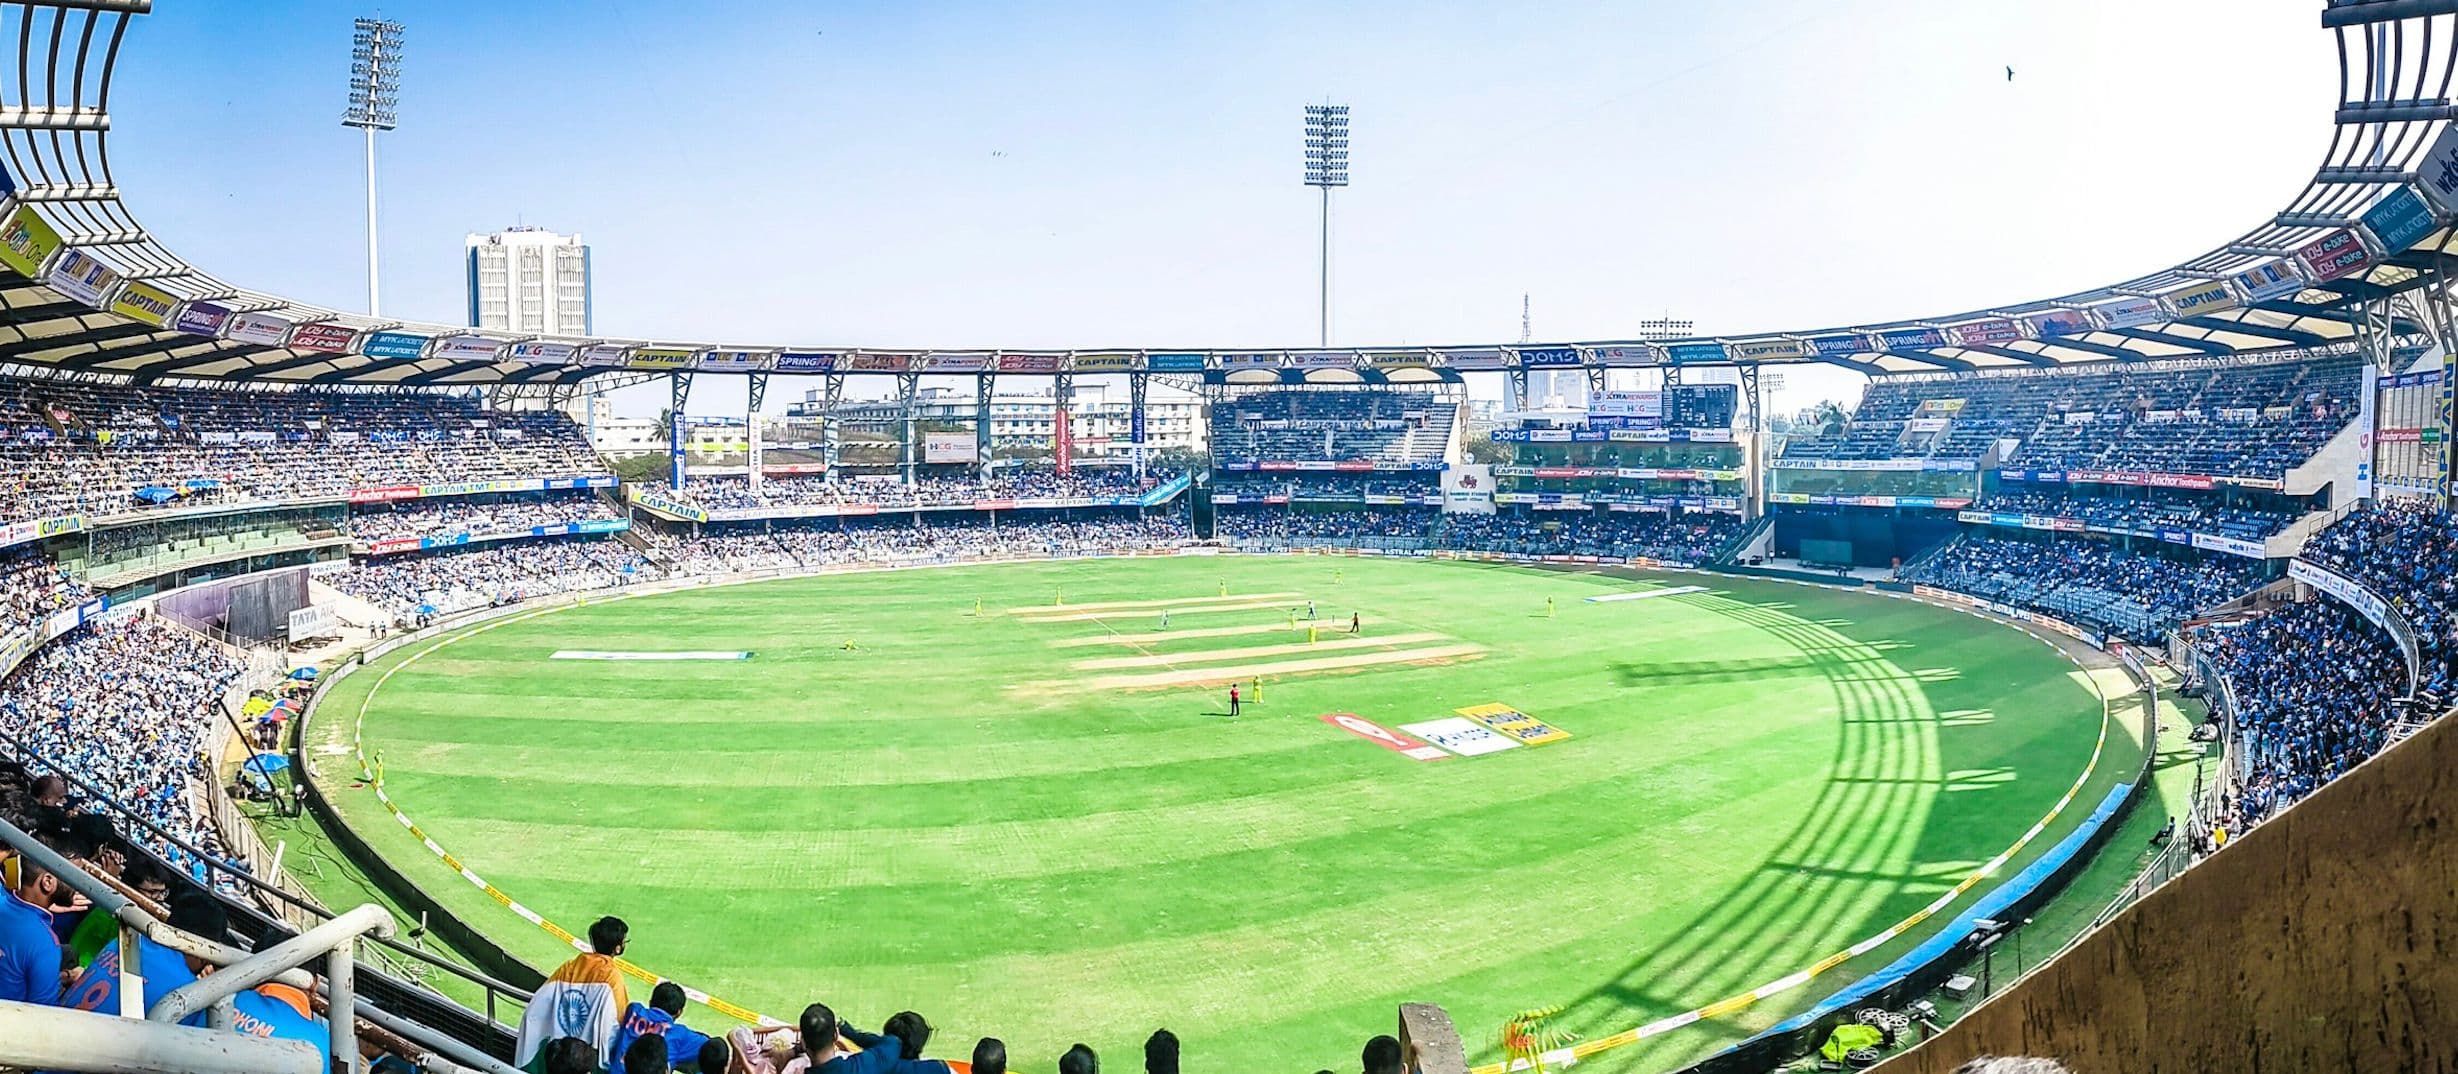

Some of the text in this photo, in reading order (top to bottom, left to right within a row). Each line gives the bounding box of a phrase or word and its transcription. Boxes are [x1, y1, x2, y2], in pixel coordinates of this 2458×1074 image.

[121, 290, 171, 317] CAPTAIN
[2176, 287, 2230, 310] CAPTAIN
[1745, 344, 1797, 355] CAPTAIN
[635, 353, 688, 363] CAPTAIN
[1077, 358, 1130, 366] CAPTAIN
[1373, 355, 1425, 363] CAPTAIN
[1524, 351, 1575, 364] DOMS
[1611, 431, 1647, 439] CAPTAIN
[1773, 460, 1817, 468] CAPTAIN
[2150, 473, 2210, 488] Anchor Toothpaste
[425, 485, 467, 495] CAPTAIN
[640, 495, 700, 519] CAPTAIN
[42, 517, 81, 535] CAPTAIN
[291, 608, 318, 627] TATA
